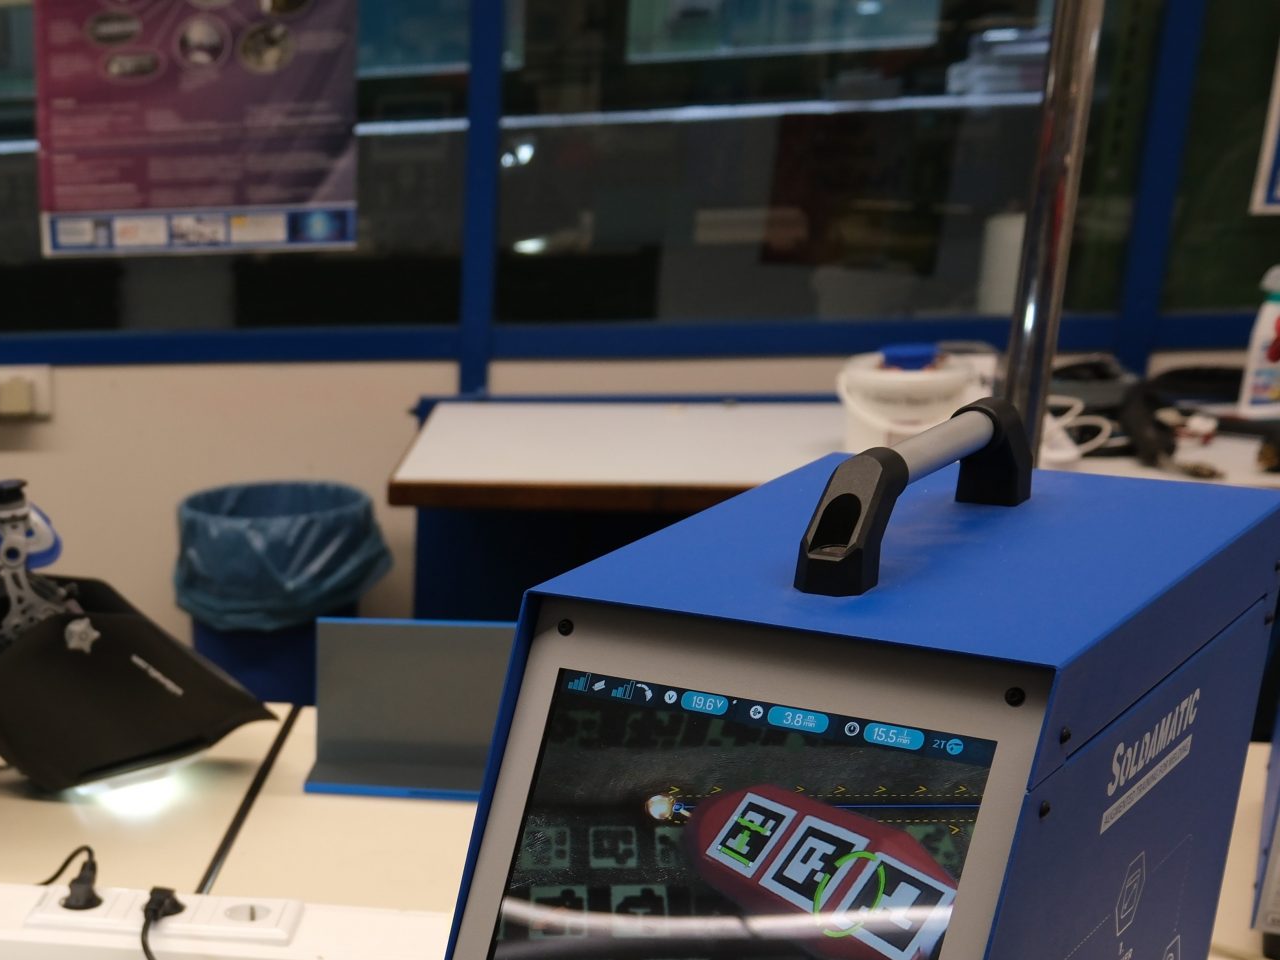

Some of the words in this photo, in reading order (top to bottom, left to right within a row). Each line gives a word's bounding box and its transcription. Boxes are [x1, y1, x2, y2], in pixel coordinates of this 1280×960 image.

[783, 711, 803, 726] 3.8
[873, 727, 897, 743] 15.5
[1107, 688, 1200, 797] SOLDAMATIC
[932, 739, 946, 749] 2T
